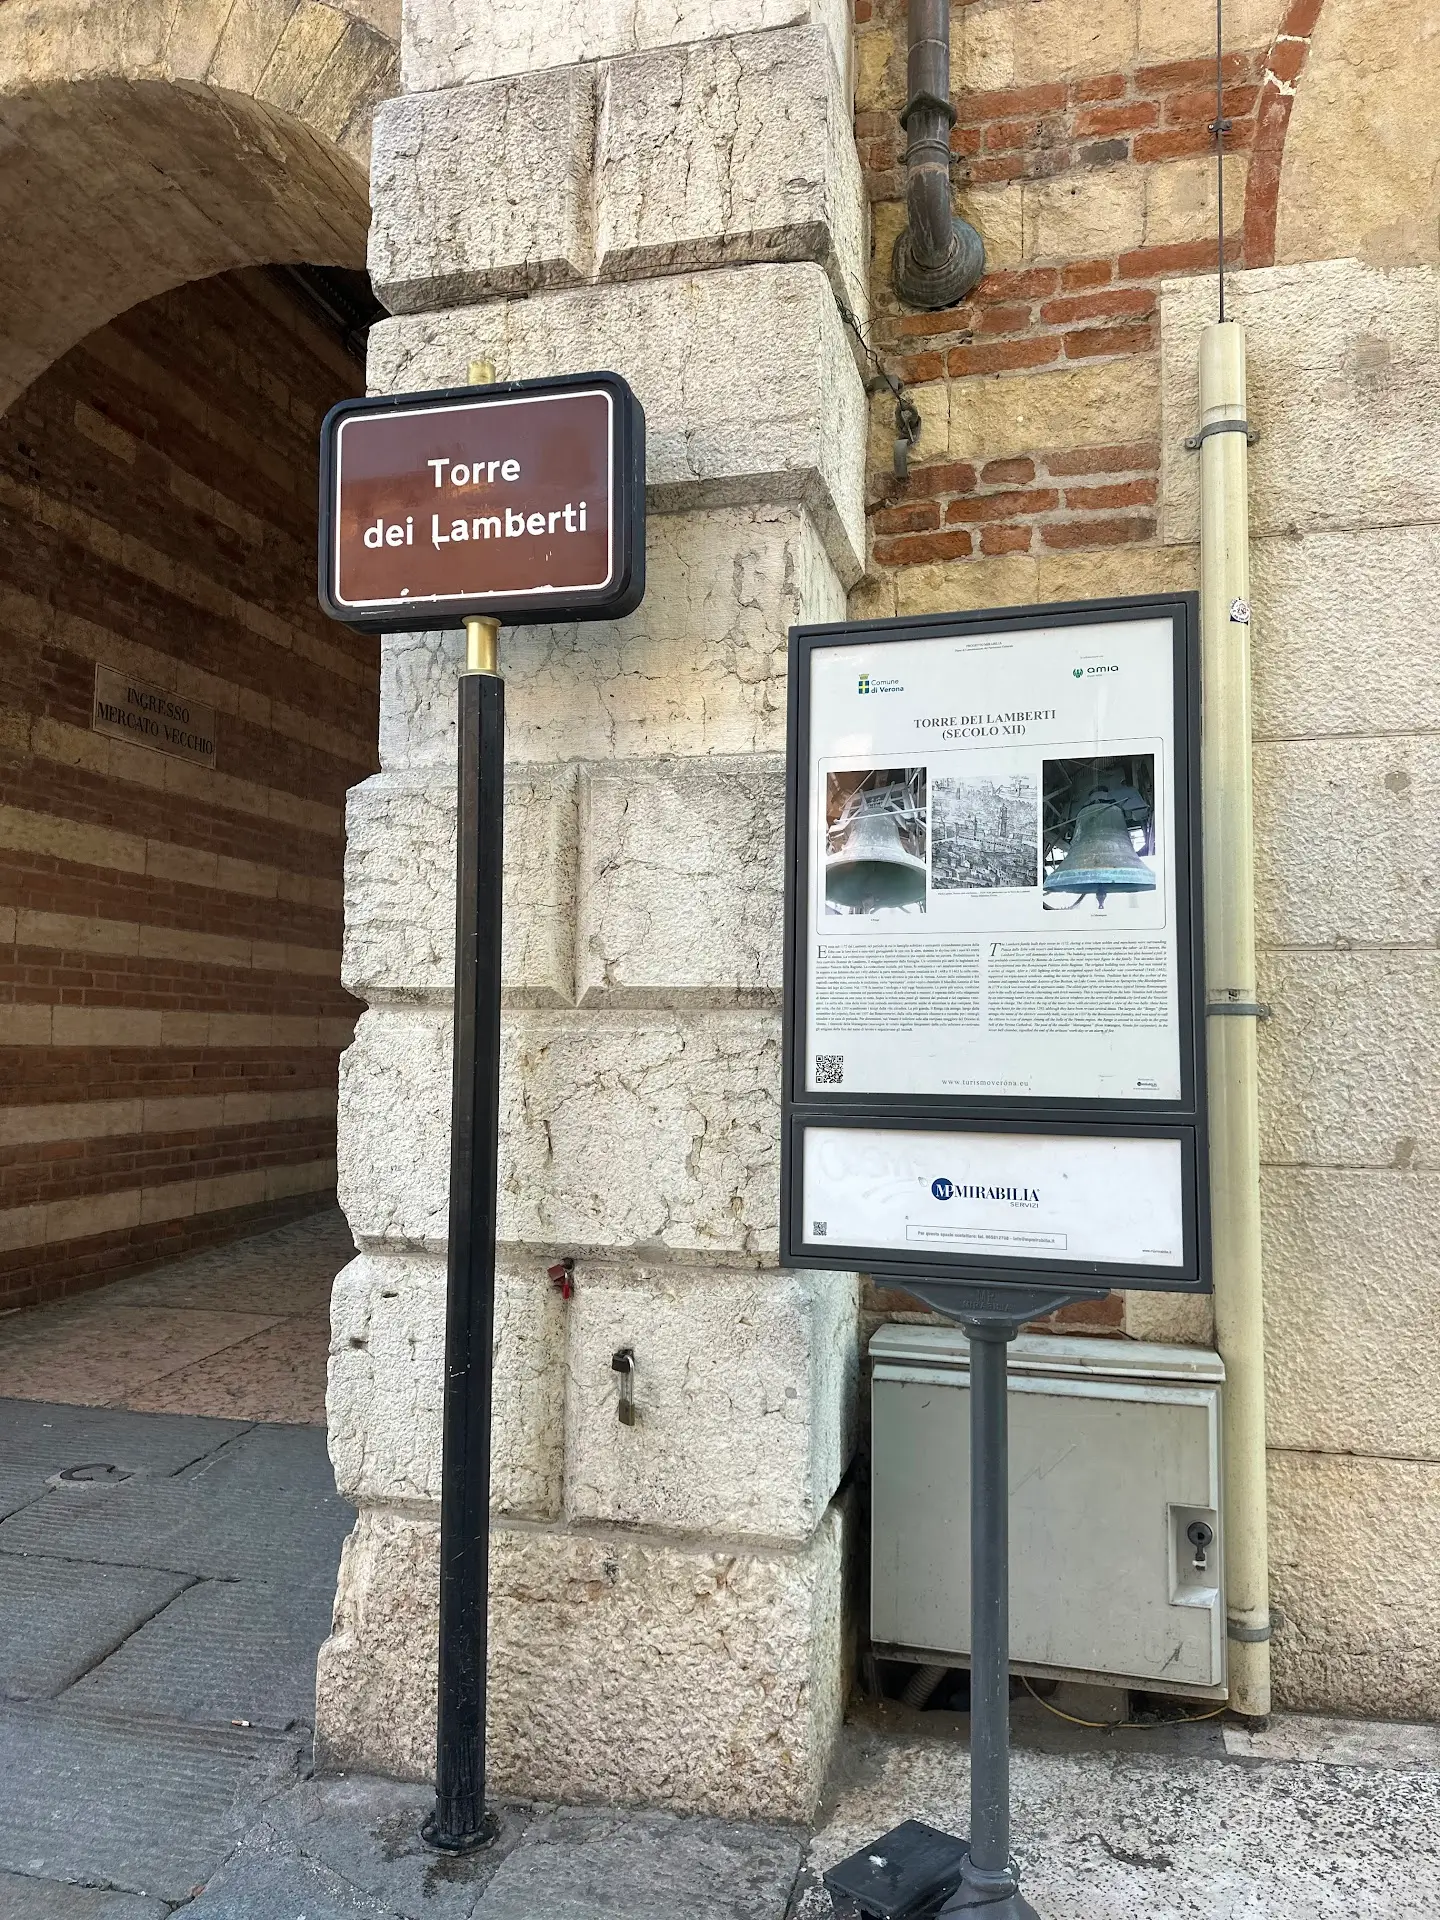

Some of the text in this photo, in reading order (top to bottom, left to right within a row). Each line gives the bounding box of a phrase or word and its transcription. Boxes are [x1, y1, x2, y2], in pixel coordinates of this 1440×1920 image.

[428, 458, 521, 488] Torre
[363, 501, 587, 549] dei Lamberti
[1087, 665, 1119, 673] amia
[127, 686, 190, 724] INGRESSO
[97, 701, 213, 755] MERCATO VECCHIO
[914, 709, 1056, 728] TORRE DEI LAMBERTI
[942, 724, 1026, 741] (SECOLO XII)
[941, 1079, 1029, 1087] www.turismoverona.eu
[1009, 1201, 1039, 1209] SERVIZI
